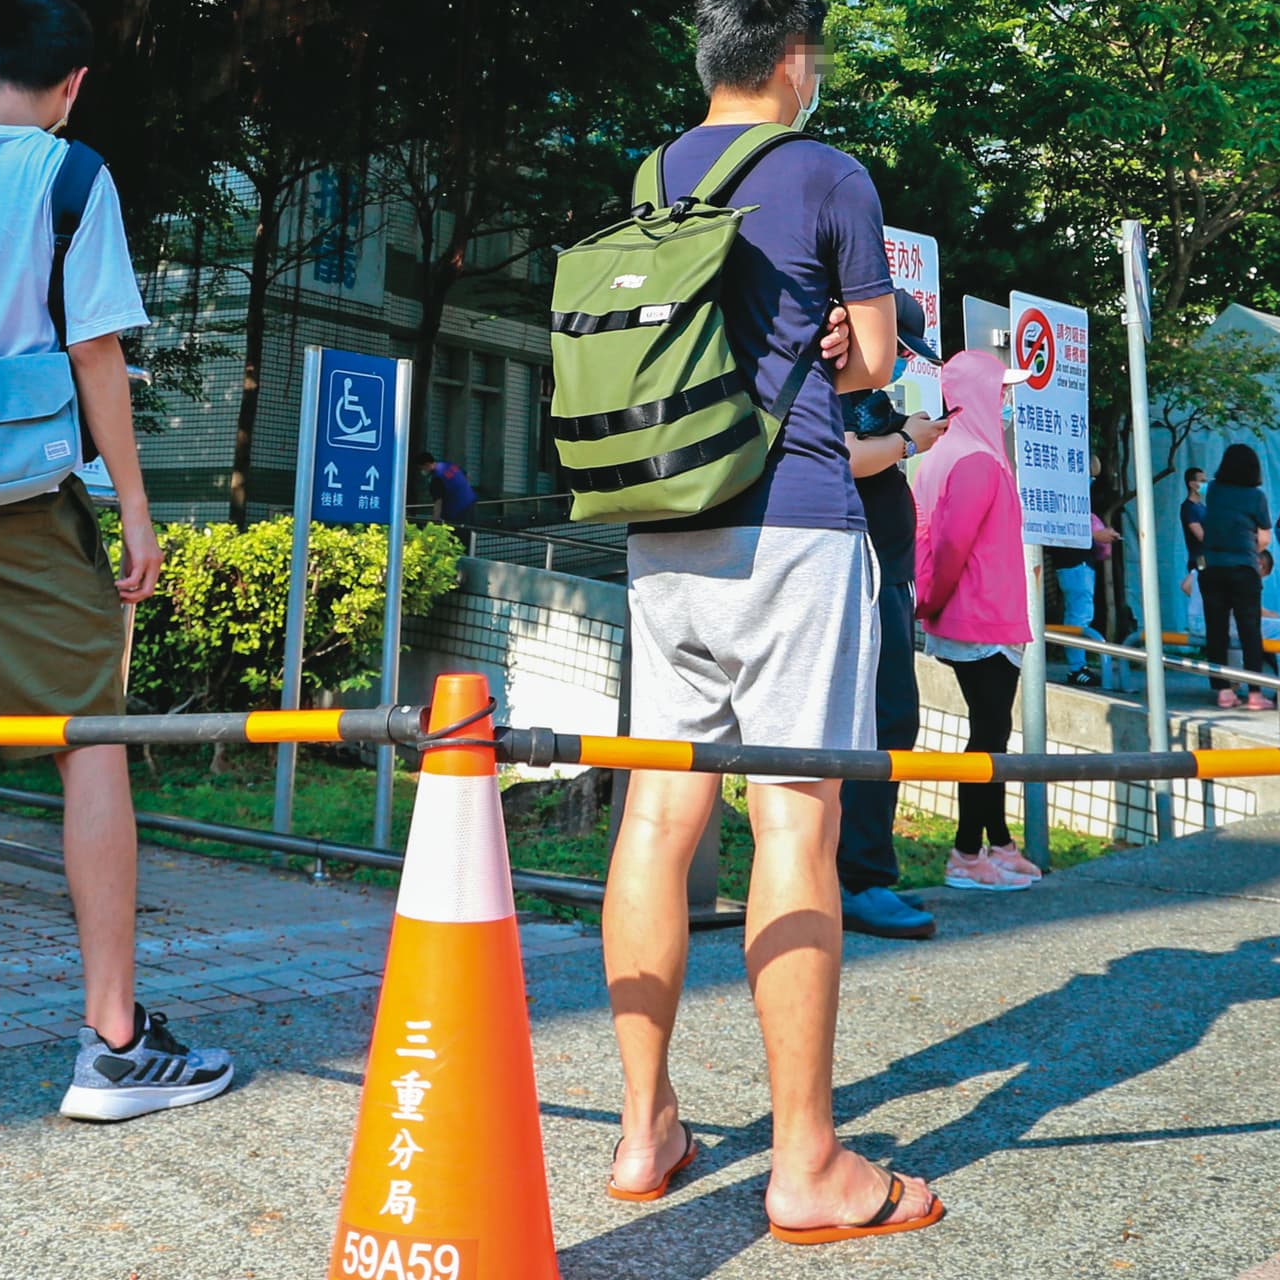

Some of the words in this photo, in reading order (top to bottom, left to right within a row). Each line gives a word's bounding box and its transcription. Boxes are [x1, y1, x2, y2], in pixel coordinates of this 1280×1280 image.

[379, 1020, 437, 1225] 三重分局
[342, 1231, 460, 1279] 59A59
